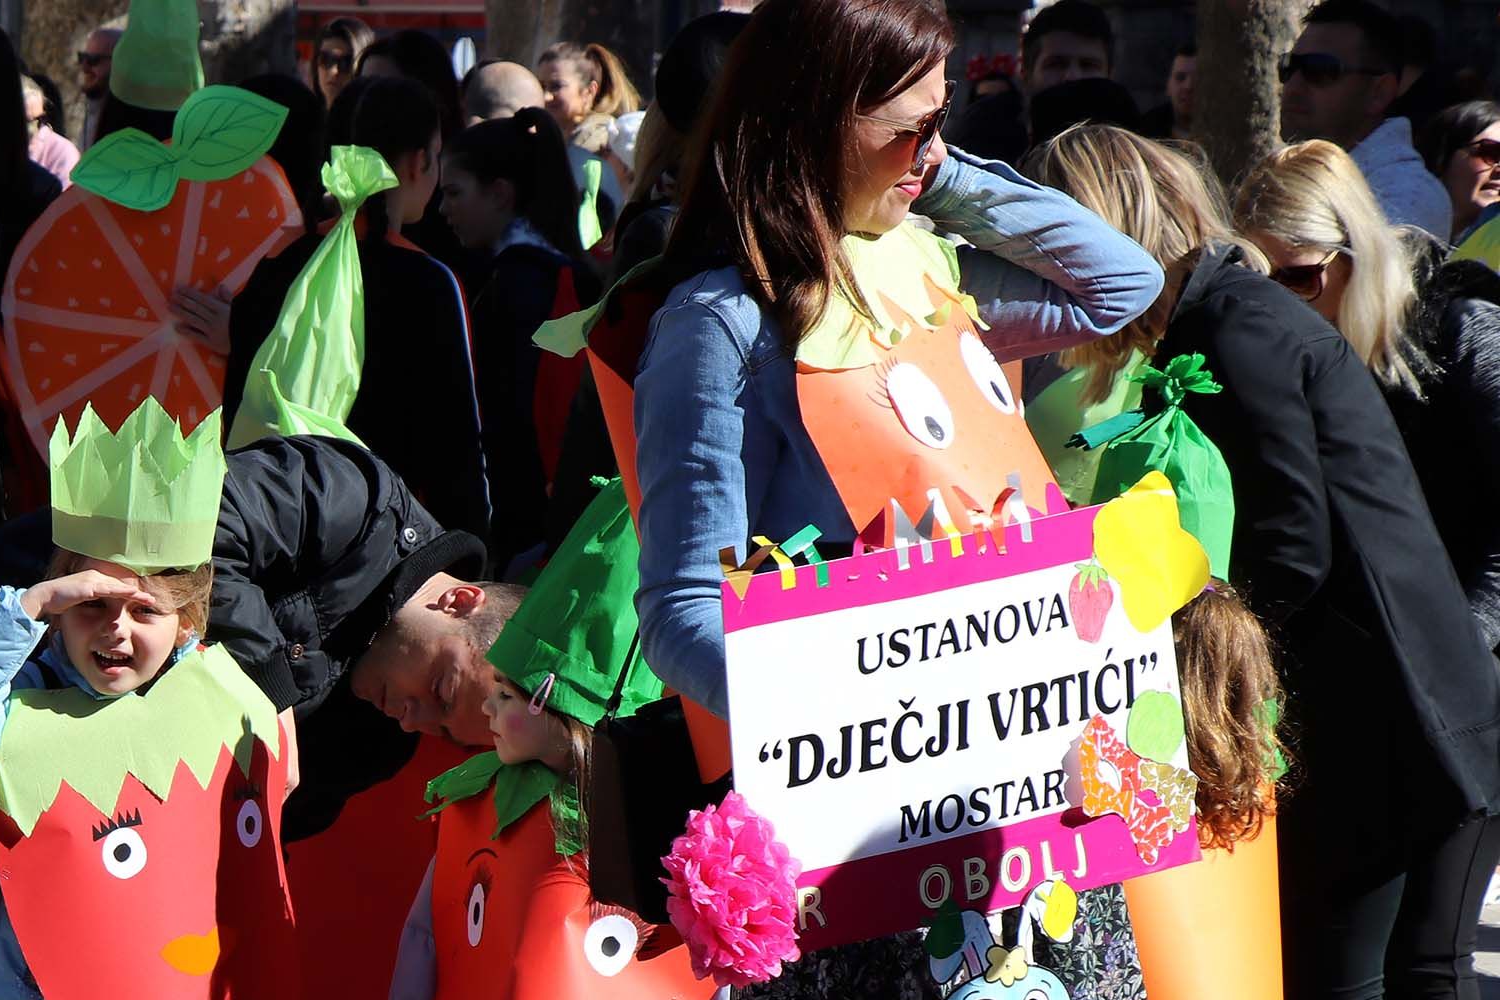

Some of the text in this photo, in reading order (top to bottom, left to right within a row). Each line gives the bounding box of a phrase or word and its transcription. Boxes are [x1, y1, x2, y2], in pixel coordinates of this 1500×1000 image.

[857, 592, 1069, 675] USTANOVA
[898, 768, 1066, 843] MOSTAR
[918, 833, 1088, 909] OBOLJ
